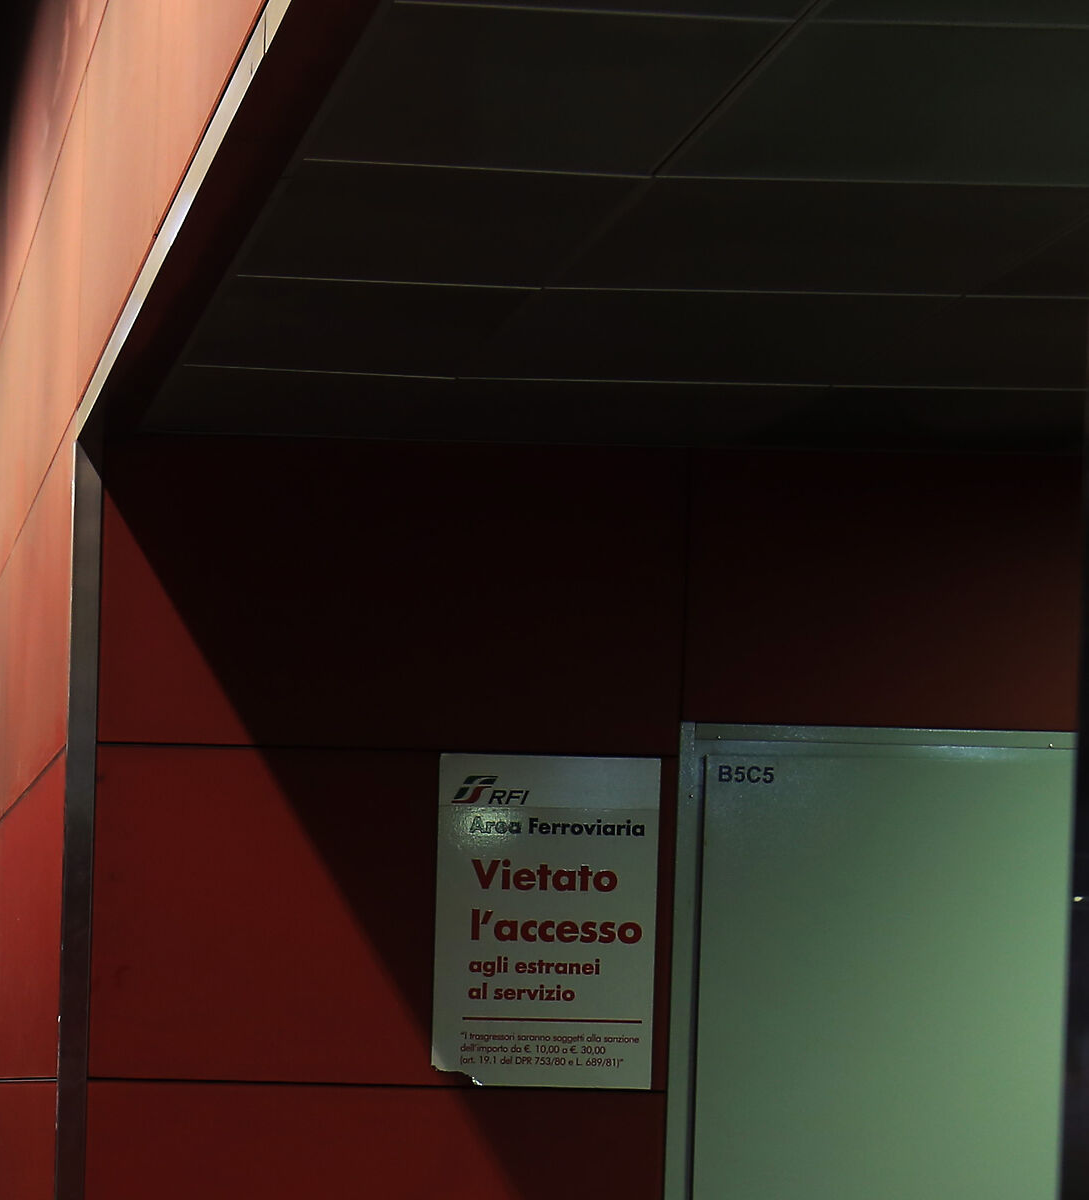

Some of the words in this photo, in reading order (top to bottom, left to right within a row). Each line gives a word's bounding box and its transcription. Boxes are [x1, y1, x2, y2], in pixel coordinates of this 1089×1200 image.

[717, 764, 776, 784] B5C5
[488, 789, 530, 805] RFI
[469, 815, 522, 835] Area
[528, 817, 646, 837] Ferroviaria
[471, 858, 618, 893] Vietato
[470, 908, 643, 945] l'accesso
[468, 955, 509, 977] agli
[514, 958, 601, 976] estranei
[468, 982, 487, 1000] al
[493, 984, 576, 1002] servizio
[469, 1033, 515, 1042] trasgressori
[552, 1033, 585, 1043] soggetti
[586, 1033, 602, 1042] alla
[604, 1034, 640, 1043] sanzione
[511, 1044, 522, 1053] da
[536, 1044, 560, 1054] 10,00
[581, 1046, 606, 1055] 30,00
[479, 1056, 496, 1064] 19.1
[500, 1056, 512, 1065] del
[515, 1056, 532, 1065] DPR
[534, 1056, 566, 1066] 753/80
